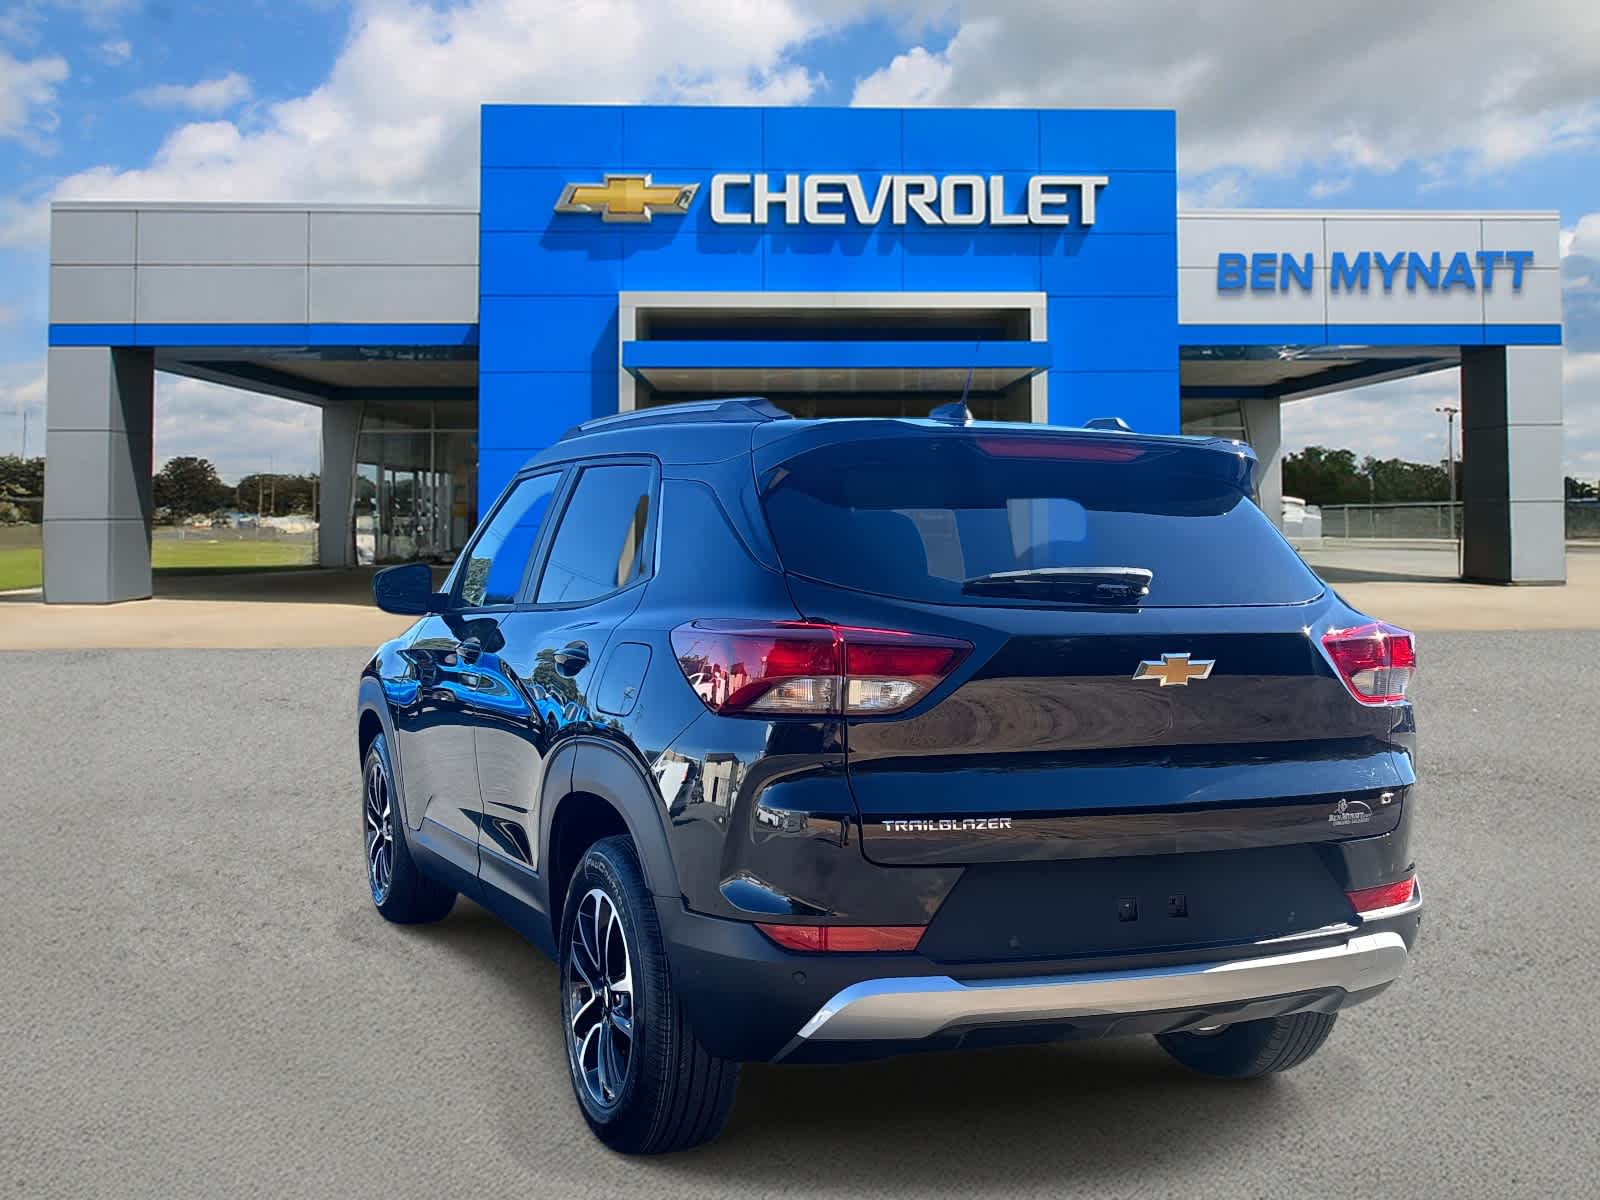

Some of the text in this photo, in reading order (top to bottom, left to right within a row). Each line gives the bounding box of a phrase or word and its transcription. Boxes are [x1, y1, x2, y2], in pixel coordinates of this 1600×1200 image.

[710, 173, 1109, 225] CHEVROLET
[1217, 250, 1534, 290] BEN MYNATT
[881, 817, 1012, 832] TRAILBLAZER
